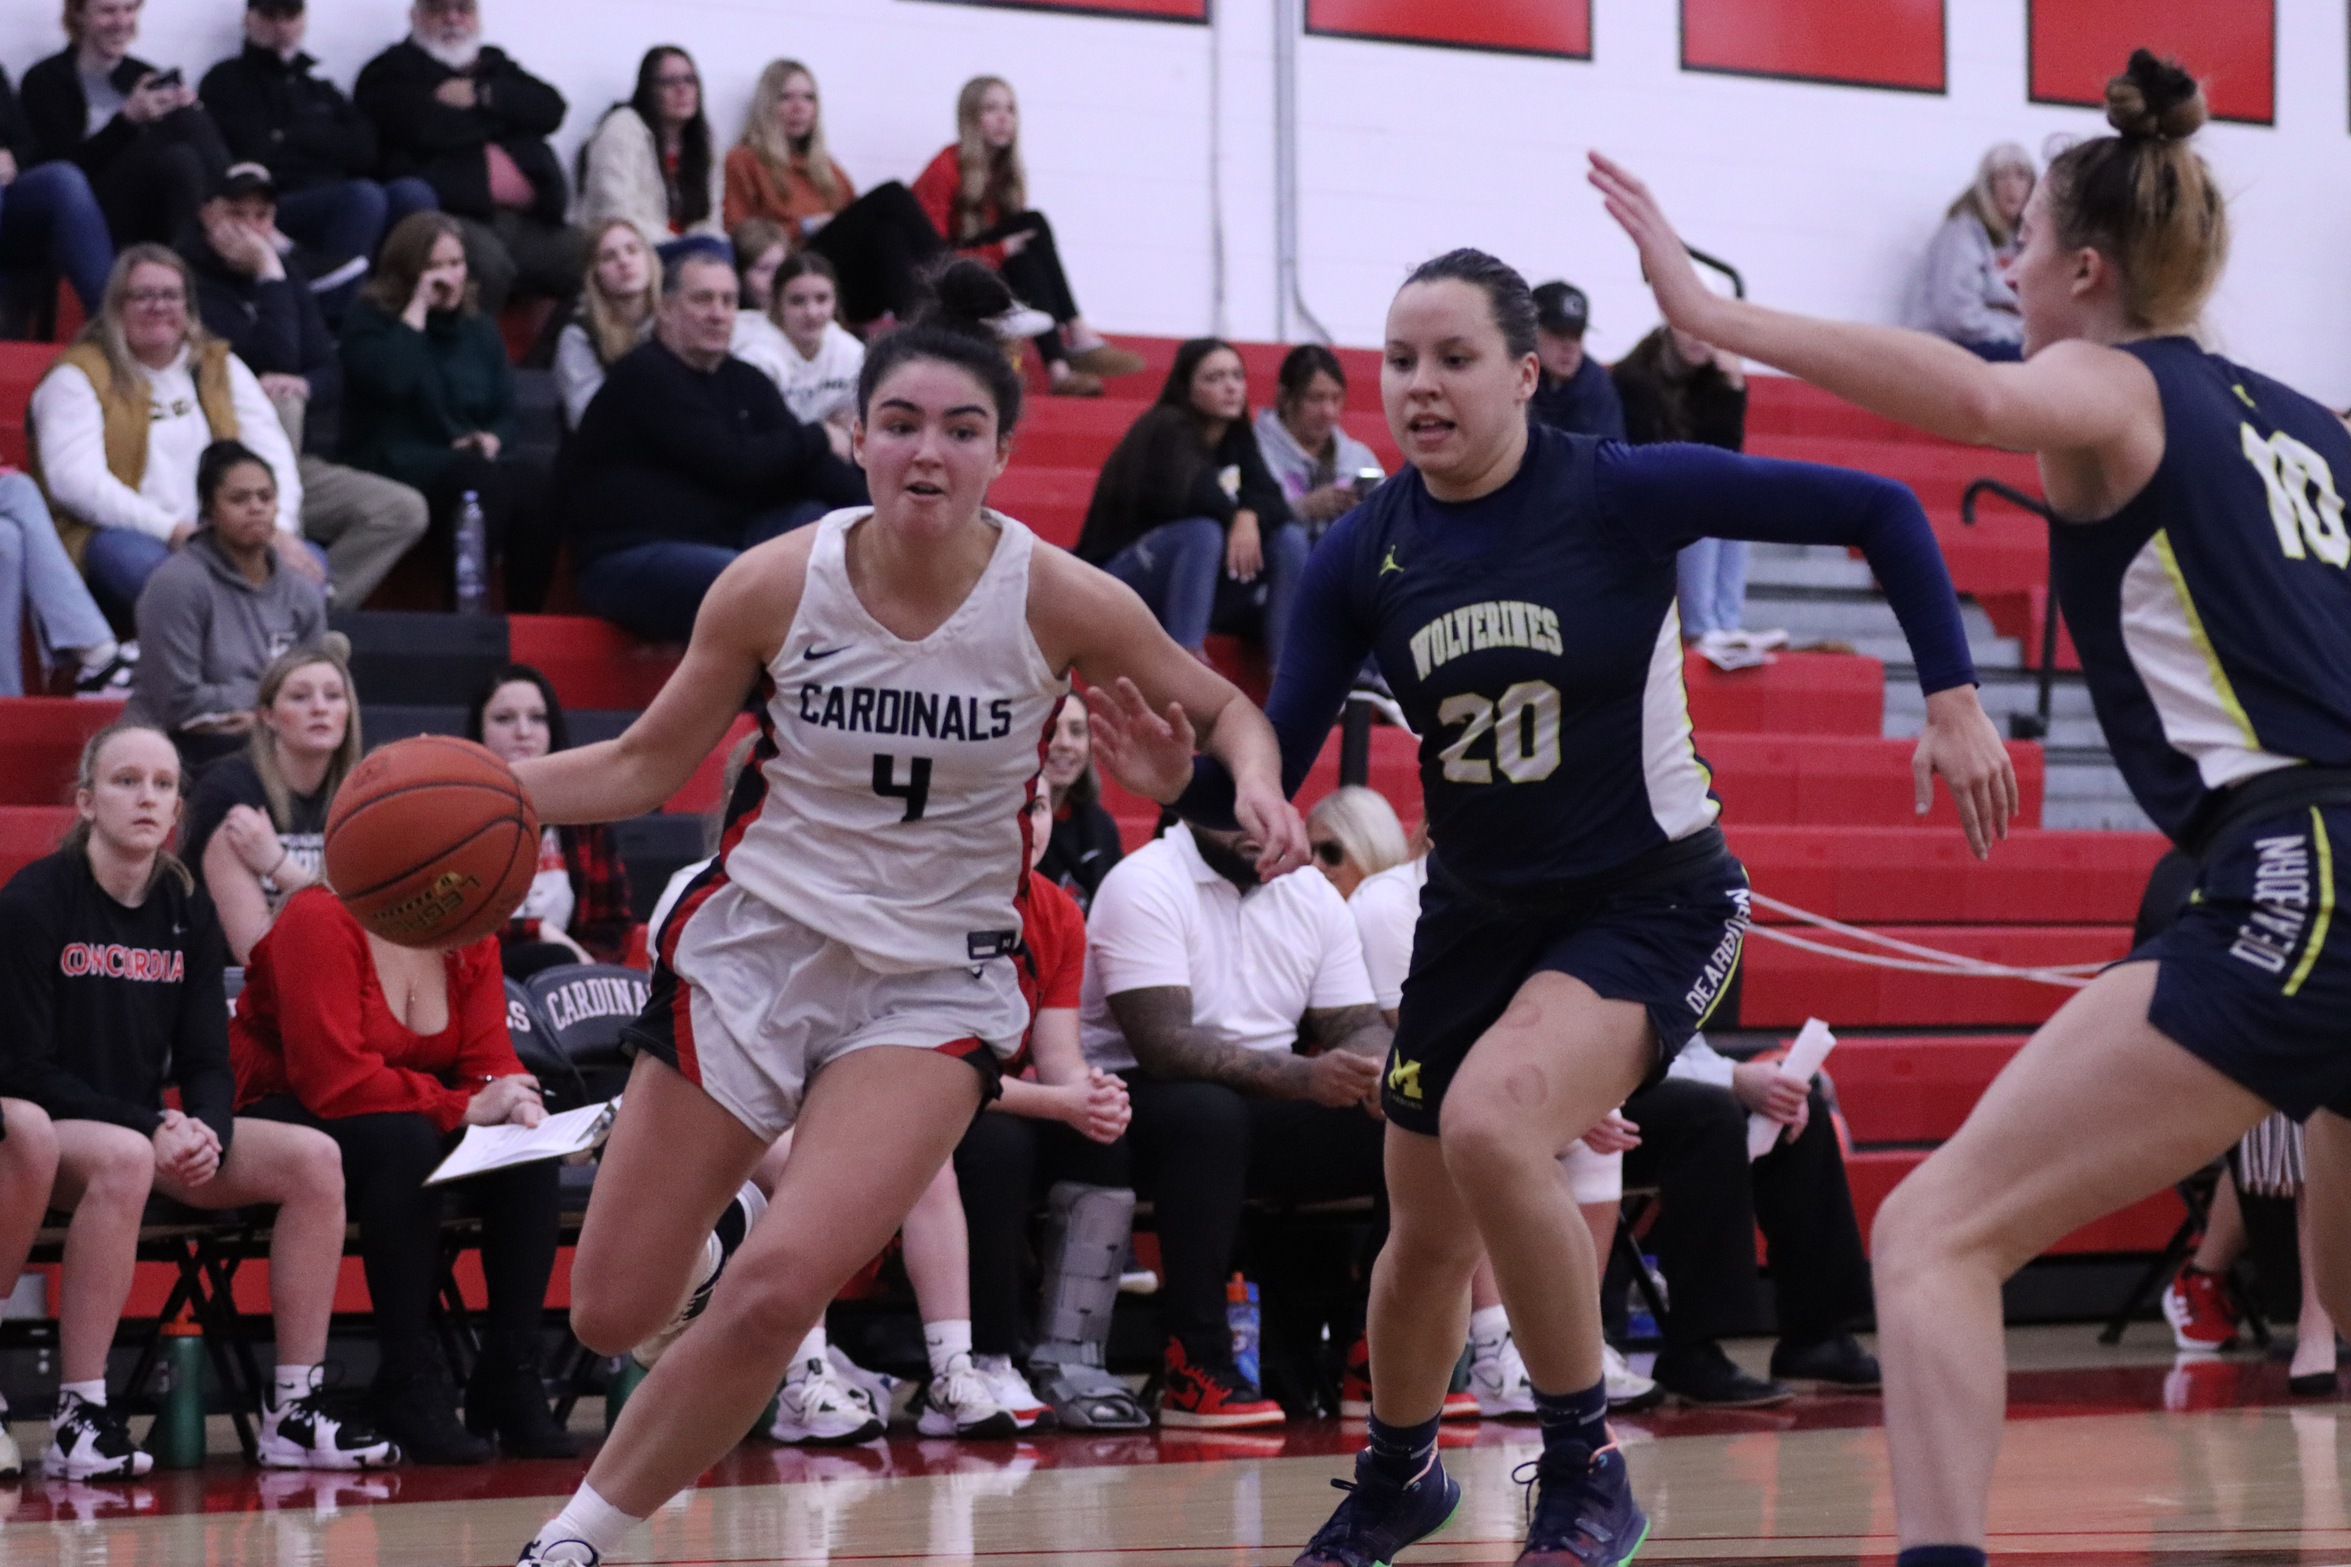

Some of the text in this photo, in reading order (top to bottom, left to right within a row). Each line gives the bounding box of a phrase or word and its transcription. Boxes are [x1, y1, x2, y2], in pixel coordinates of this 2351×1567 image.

[2240, 421, 2351, 569] 10
[1409, 600, 1564, 682] WOLVERINES
[800, 682, 1013, 742] CARDINALS
[1437, 679, 1562, 784] 20
[871, 753, 933, 823] 4
[61, 942, 184, 982] CONCORDIA
[545, 977, 652, 1032] CARDINA
[1388, 1047, 1423, 1100] M
